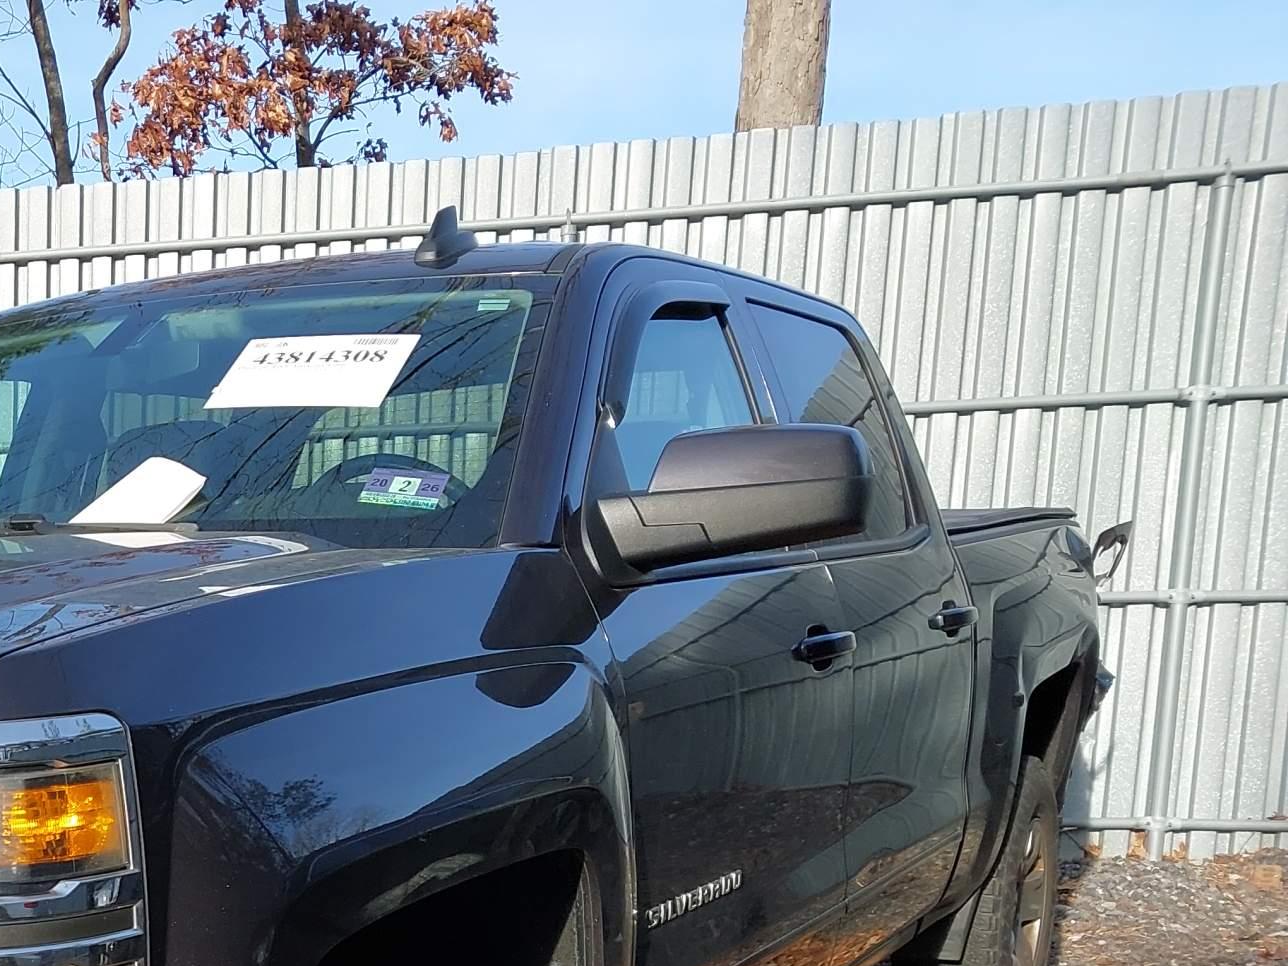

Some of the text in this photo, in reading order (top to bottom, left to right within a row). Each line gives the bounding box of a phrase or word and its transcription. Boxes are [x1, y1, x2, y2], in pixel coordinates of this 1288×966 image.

[253, 349, 388, 366] 43814308
[370, 478, 439, 493] 20 2 26
[645, 869, 743, 929] SILVERADO
